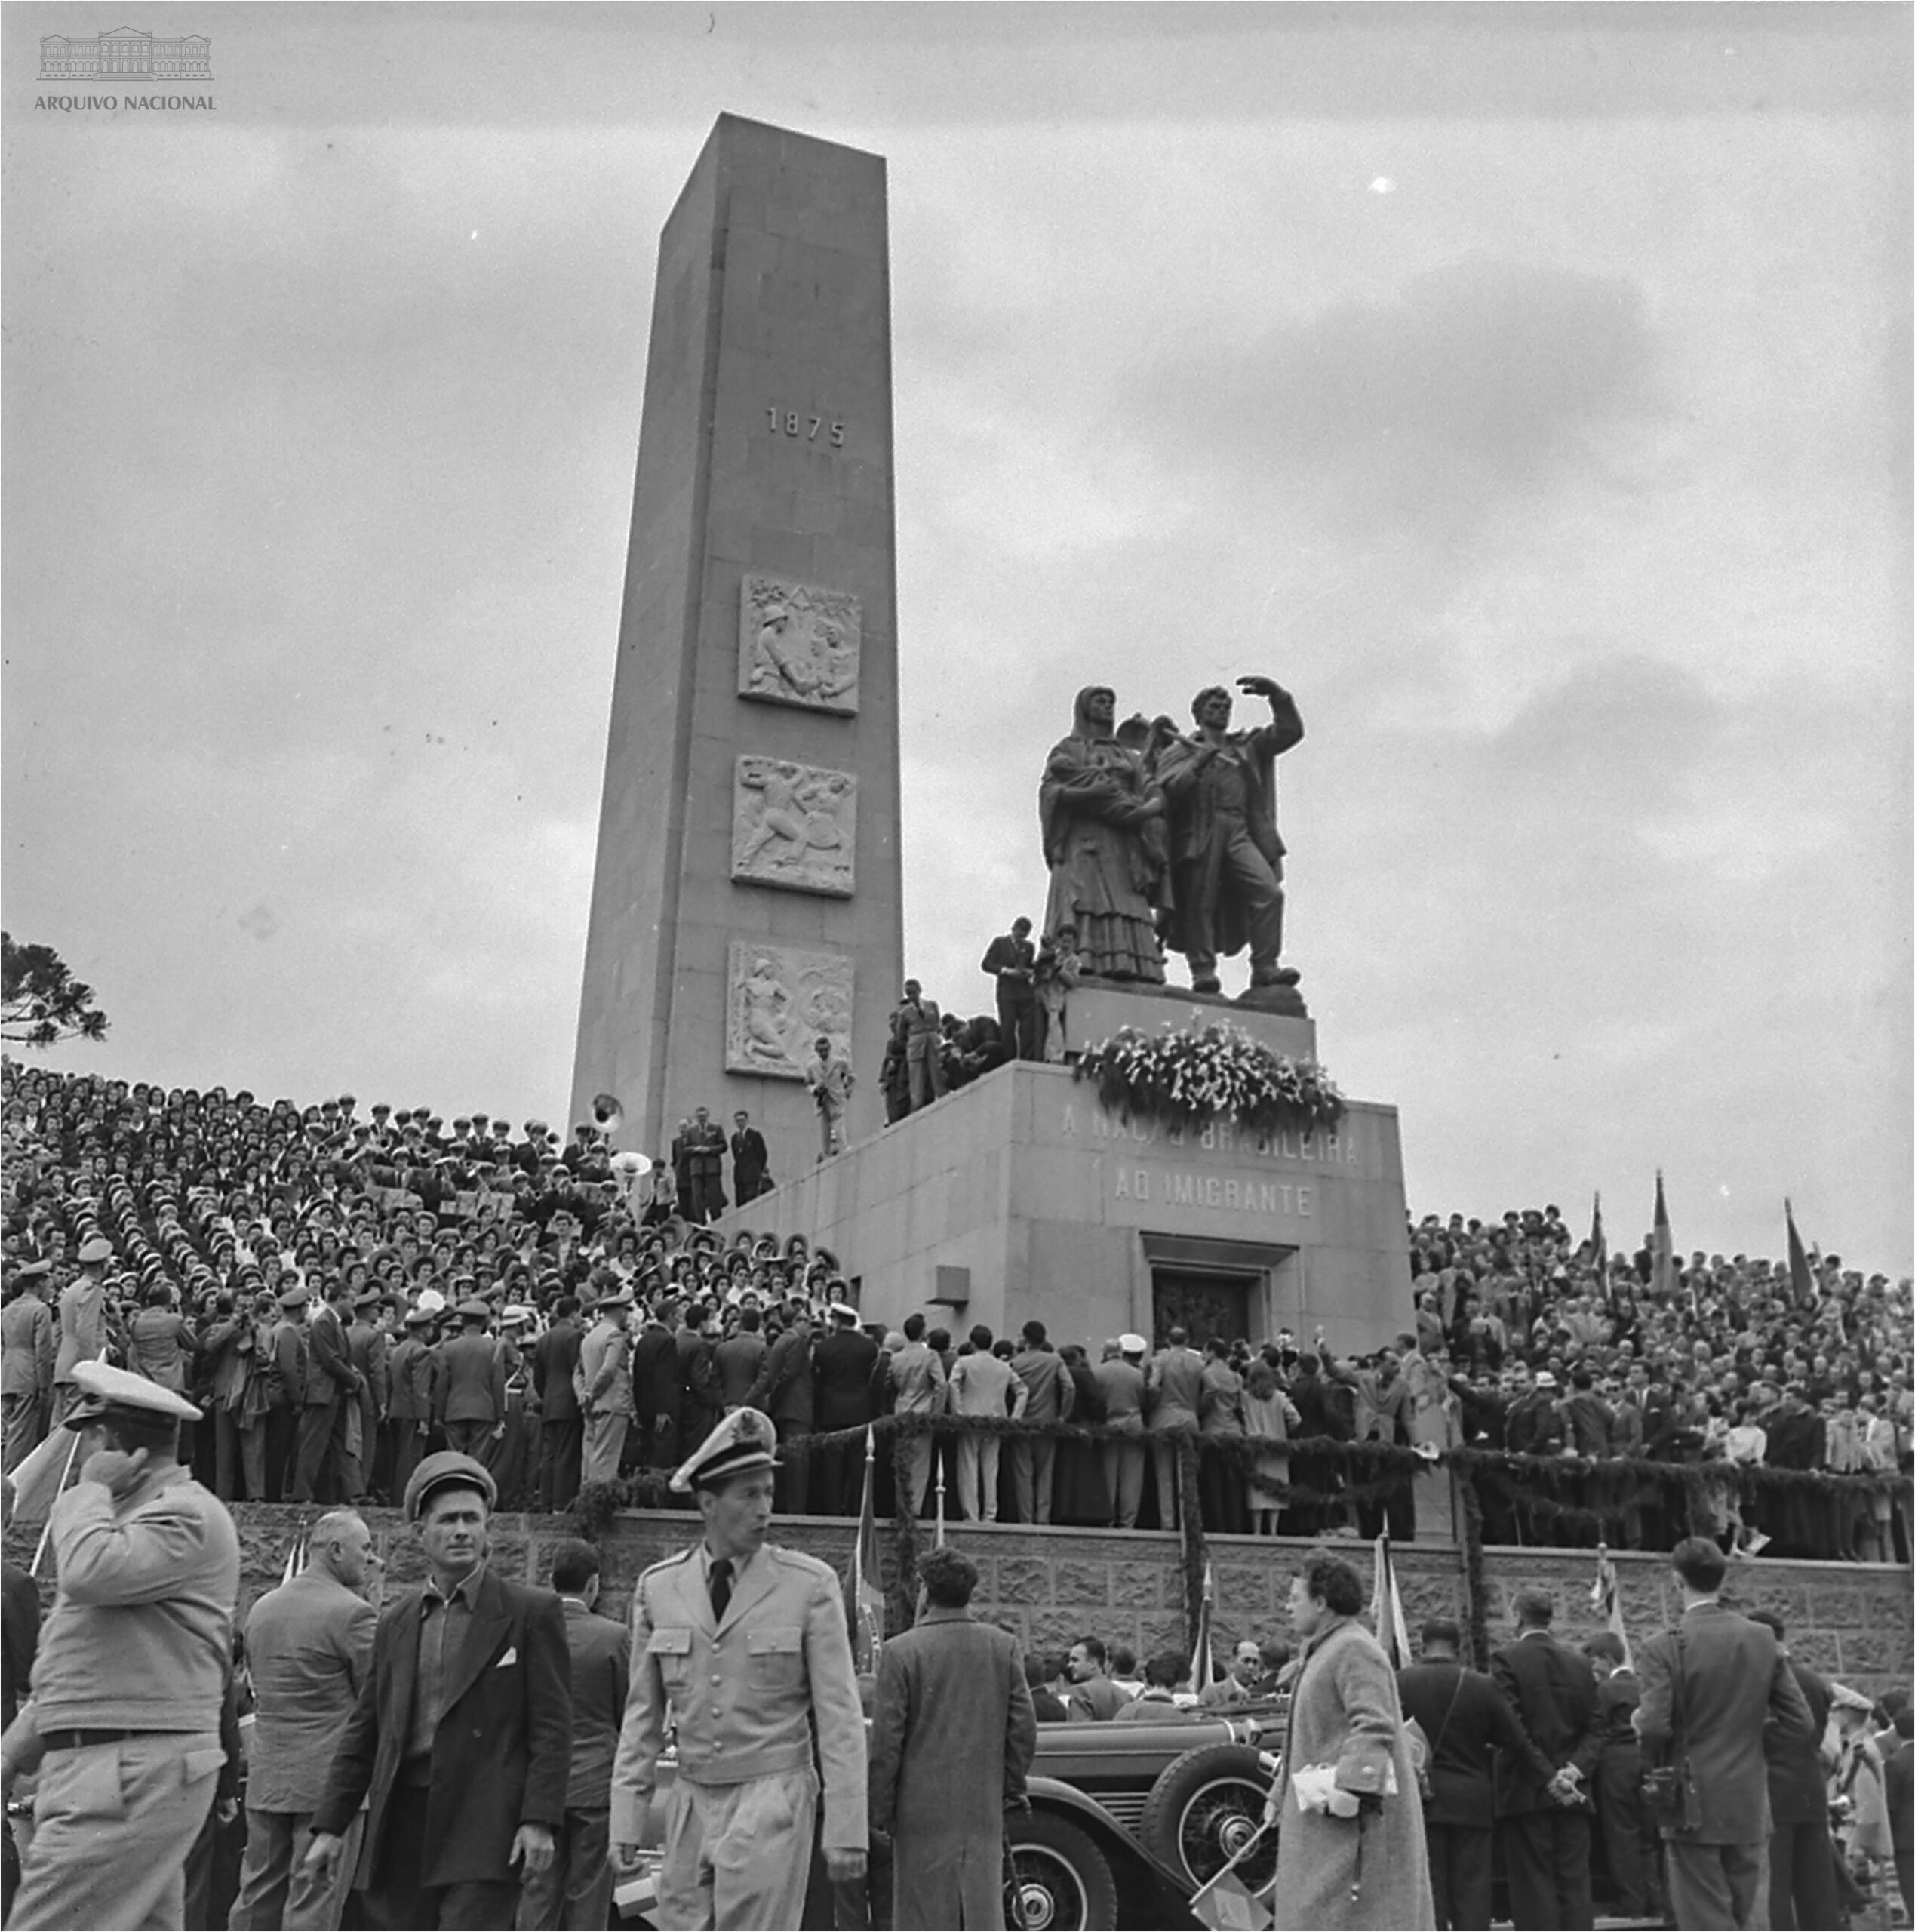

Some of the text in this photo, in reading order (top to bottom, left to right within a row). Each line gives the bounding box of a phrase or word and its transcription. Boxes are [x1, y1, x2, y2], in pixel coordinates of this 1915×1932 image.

[766, 406, 844, 447] 1875
[1063, 1104, 1075, 1137] A
[1115, 1169, 1312, 1218] AO IMIGRANTE
